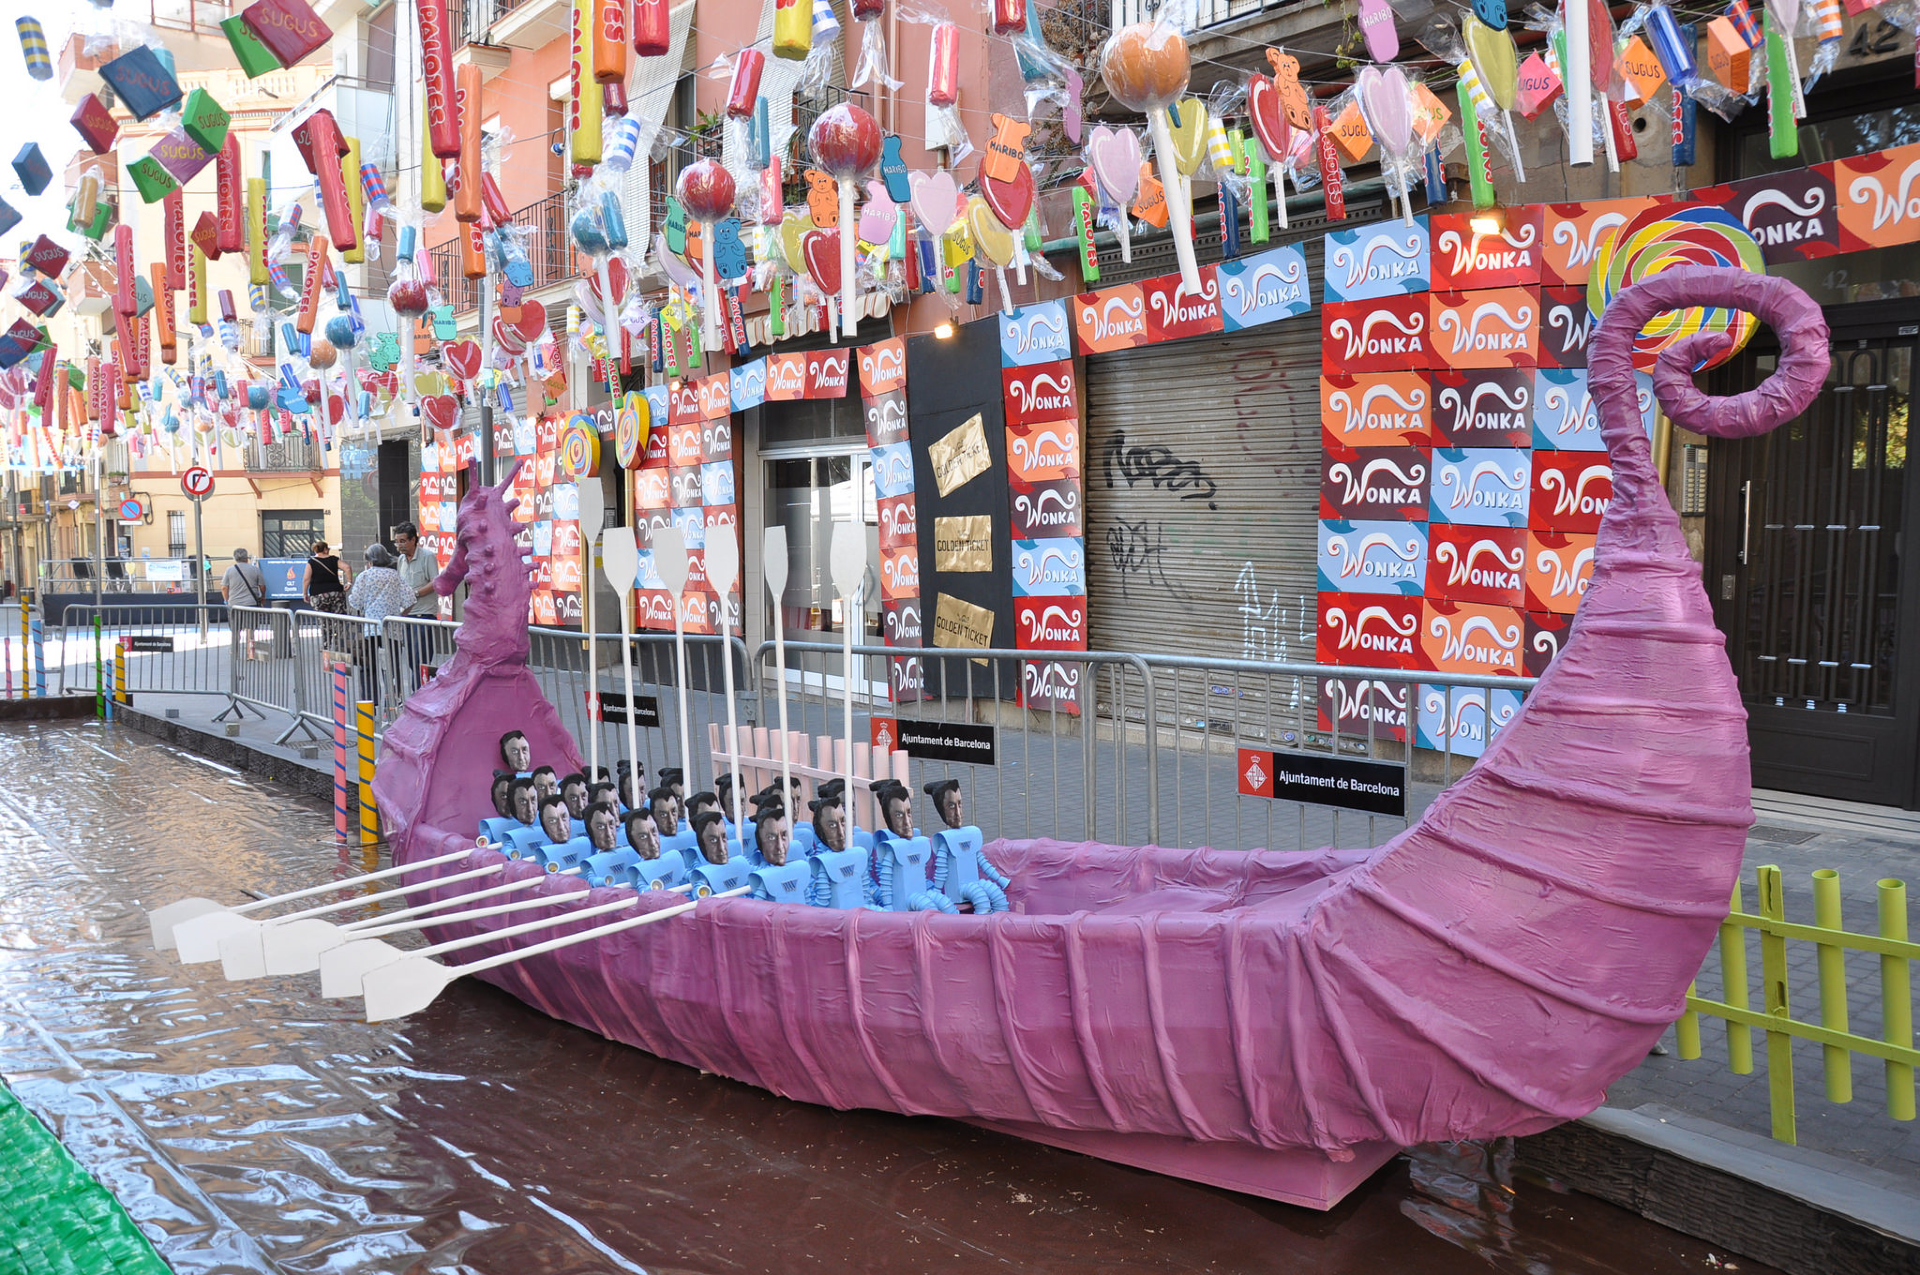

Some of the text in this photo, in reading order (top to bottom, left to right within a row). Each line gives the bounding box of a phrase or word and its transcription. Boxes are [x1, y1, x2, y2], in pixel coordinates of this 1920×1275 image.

[260, 7, 319, 37] SUGUS
[1362, 6, 1393, 28] HARIBO
[1848, 20, 1900, 56] 42
[115, 66, 171, 96] SUGUS
[420, 5, 446, 127] PALOTES
[1625, 61, 1660, 78] SUGUS
[1518, 76, 1550, 94] UGUS
[86, 113, 114, 132] SUGUS
[198, 113, 226, 129] SUGUS
[1341, 125, 1371, 138] SUGU
[160, 144, 206, 160] SUGUS
[989, 140, 1025, 161] HARIBO
[1321, 125, 1343, 205] PALOTES
[141, 163, 172, 188] SUGUS
[883, 164, 908, 175] HARIBO
[217, 147, 234, 232] PALOTES
[1138, 190, 1165, 213] SUGUS
[668, 219, 686, 235] HARIBO
[863, 207, 896, 223] HARIBO
[174, 199, 185, 275] PALOTES
[195, 228, 216, 241] SUGUS
[953, 233, 970, 255] SUGUS
[1082, 202, 1098, 268] PALOTES
[1439, 223, 1536, 277] WONKA
[34, 247, 65, 262] SUGUS
[1333, 234, 1422, 288] WONKA
[300, 250, 321, 314] PALOTES
[1226, 261, 1302, 315] WONKA
[1822, 269, 1848, 289] 42
[730, 296, 746, 344] PALOTES
[1082, 297, 1143, 342] WONKA
[1151, 279, 1218, 328] WONKA
[140, 317, 149, 366] PALOTES
[414, 333, 431, 341] ARIBO
[1006, 313, 1065, 355] WONKA
[1329, 310, 1425, 360] WONKA
[1438, 302, 1532, 354] WONKA
[664, 322, 677, 370] PALOTES
[608, 357, 621, 399] PALOTES
[734, 367, 765, 402] WONKA
[770, 360, 806, 391] WONKA
[809, 356, 847, 389] WONKA
[863, 348, 903, 386] WONKA
[92, 366, 100, 409] PALOTES
[671, 388, 699, 416] WONKA
[702, 381, 730, 410] WONKA
[1009, 374, 1071, 413] WONKA
[868, 400, 906, 435] WONKA
[1329, 384, 1426, 433] WONKA
[1439, 382, 1529, 432] WONKA
[671, 430, 700, 458] WONKA
[704, 425, 731, 454] WONKA
[1013, 431, 1074, 472] WONKA
[672, 473, 701, 499] WONKA
[877, 452, 912, 488] WONKA
[1328, 458, 1426, 505] WONKA
[1440, 460, 1527, 509] WONKA
[1539, 464, 1614, 517] WON
[882, 503, 916, 536] WONKA
[1015, 489, 1077, 528] WONKA
[937, 539, 989, 552] GOLDEN TICKET
[1327, 532, 1420, 578] WONKA
[884, 555, 918, 589] WONKA
[1019, 548, 1079, 585] WONKA
[1436, 539, 1525, 591] WONKA
[639, 594, 672, 621] WONKA
[887, 606, 921, 640] WONK
[1021, 606, 1082, 643] WONKA
[936, 616, 989, 647] GOLDEN TICKET
[1326, 605, 1417, 653] WONKA
[1430, 616, 1520, 667] WONKA
[901, 733, 991, 750] Ajuntament de Barcelona
[1279, 770, 1400, 797] Ajuntament de Barcelona
